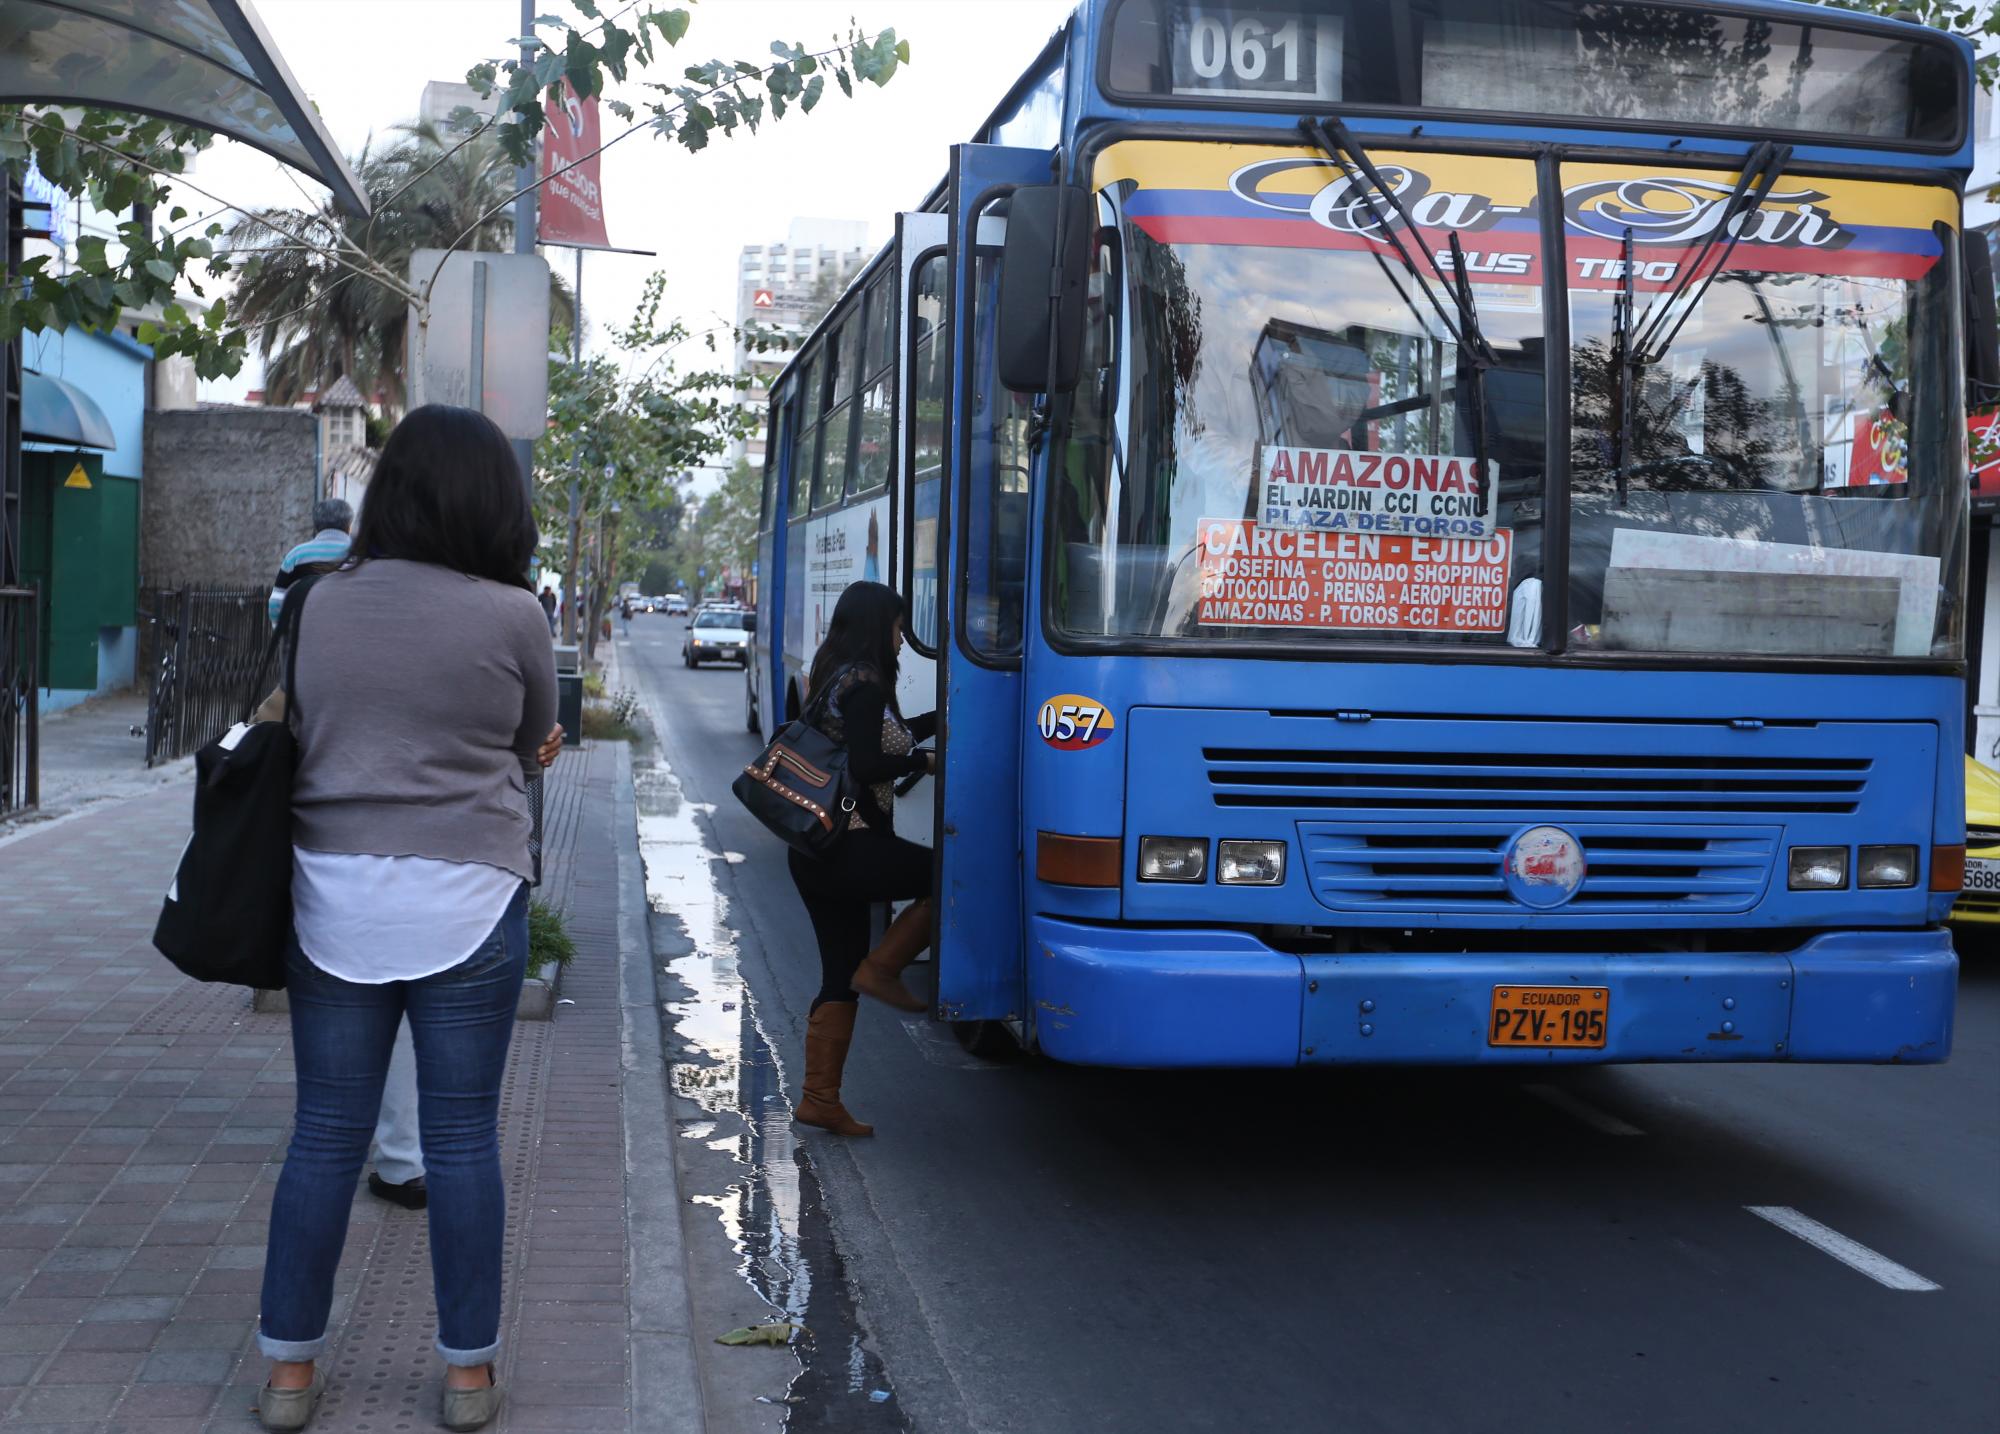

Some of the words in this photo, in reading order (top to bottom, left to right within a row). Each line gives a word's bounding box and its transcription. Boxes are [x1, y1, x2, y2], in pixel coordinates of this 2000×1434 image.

[1190, 17, 1298, 80] 061
[549, 179, 569, 199] que
[1434, 249, 1534, 275] BUS
[1575, 257, 1680, 283] TIPO
[1268, 450, 1484, 496] AMAZONAS
[1267, 484, 1291, 507] EL
[1297, 487, 1372, 511] JARDIN
[1385, 492, 1418, 514] CCI
[1266, 508, 1349, 529] PLAZA
[1358, 513, 1390, 531] DE
[1400, 516, 1484, 537] TOROS
[1205, 523, 1381, 560] CARCELEN
[1411, 533, 1506, 564] EJIDO
[1214, 558, 1306, 579] JOSEFINA
[1322, 561, 1408, 582] CONDADO
[1414, 564, 1503, 585] SHOPPING
[1202, 579, 1310, 602] COTOCOLLAO
[1324, 581, 1386, 604] PRENSA
[1400, 584, 1503, 607] AEROPUERTO
[1202, 601, 1304, 622] AMAZONAS
[1320, 604, 1333, 622] P.
[1339, 605, 1399, 624] TOROS
[1454, 608, 1503, 627] CCNU
[1041, 704, 1104, 743] 057
[1522, 992, 1581, 1006] ECUADOR
[1493, 1008, 1603, 1041] PZV-195
